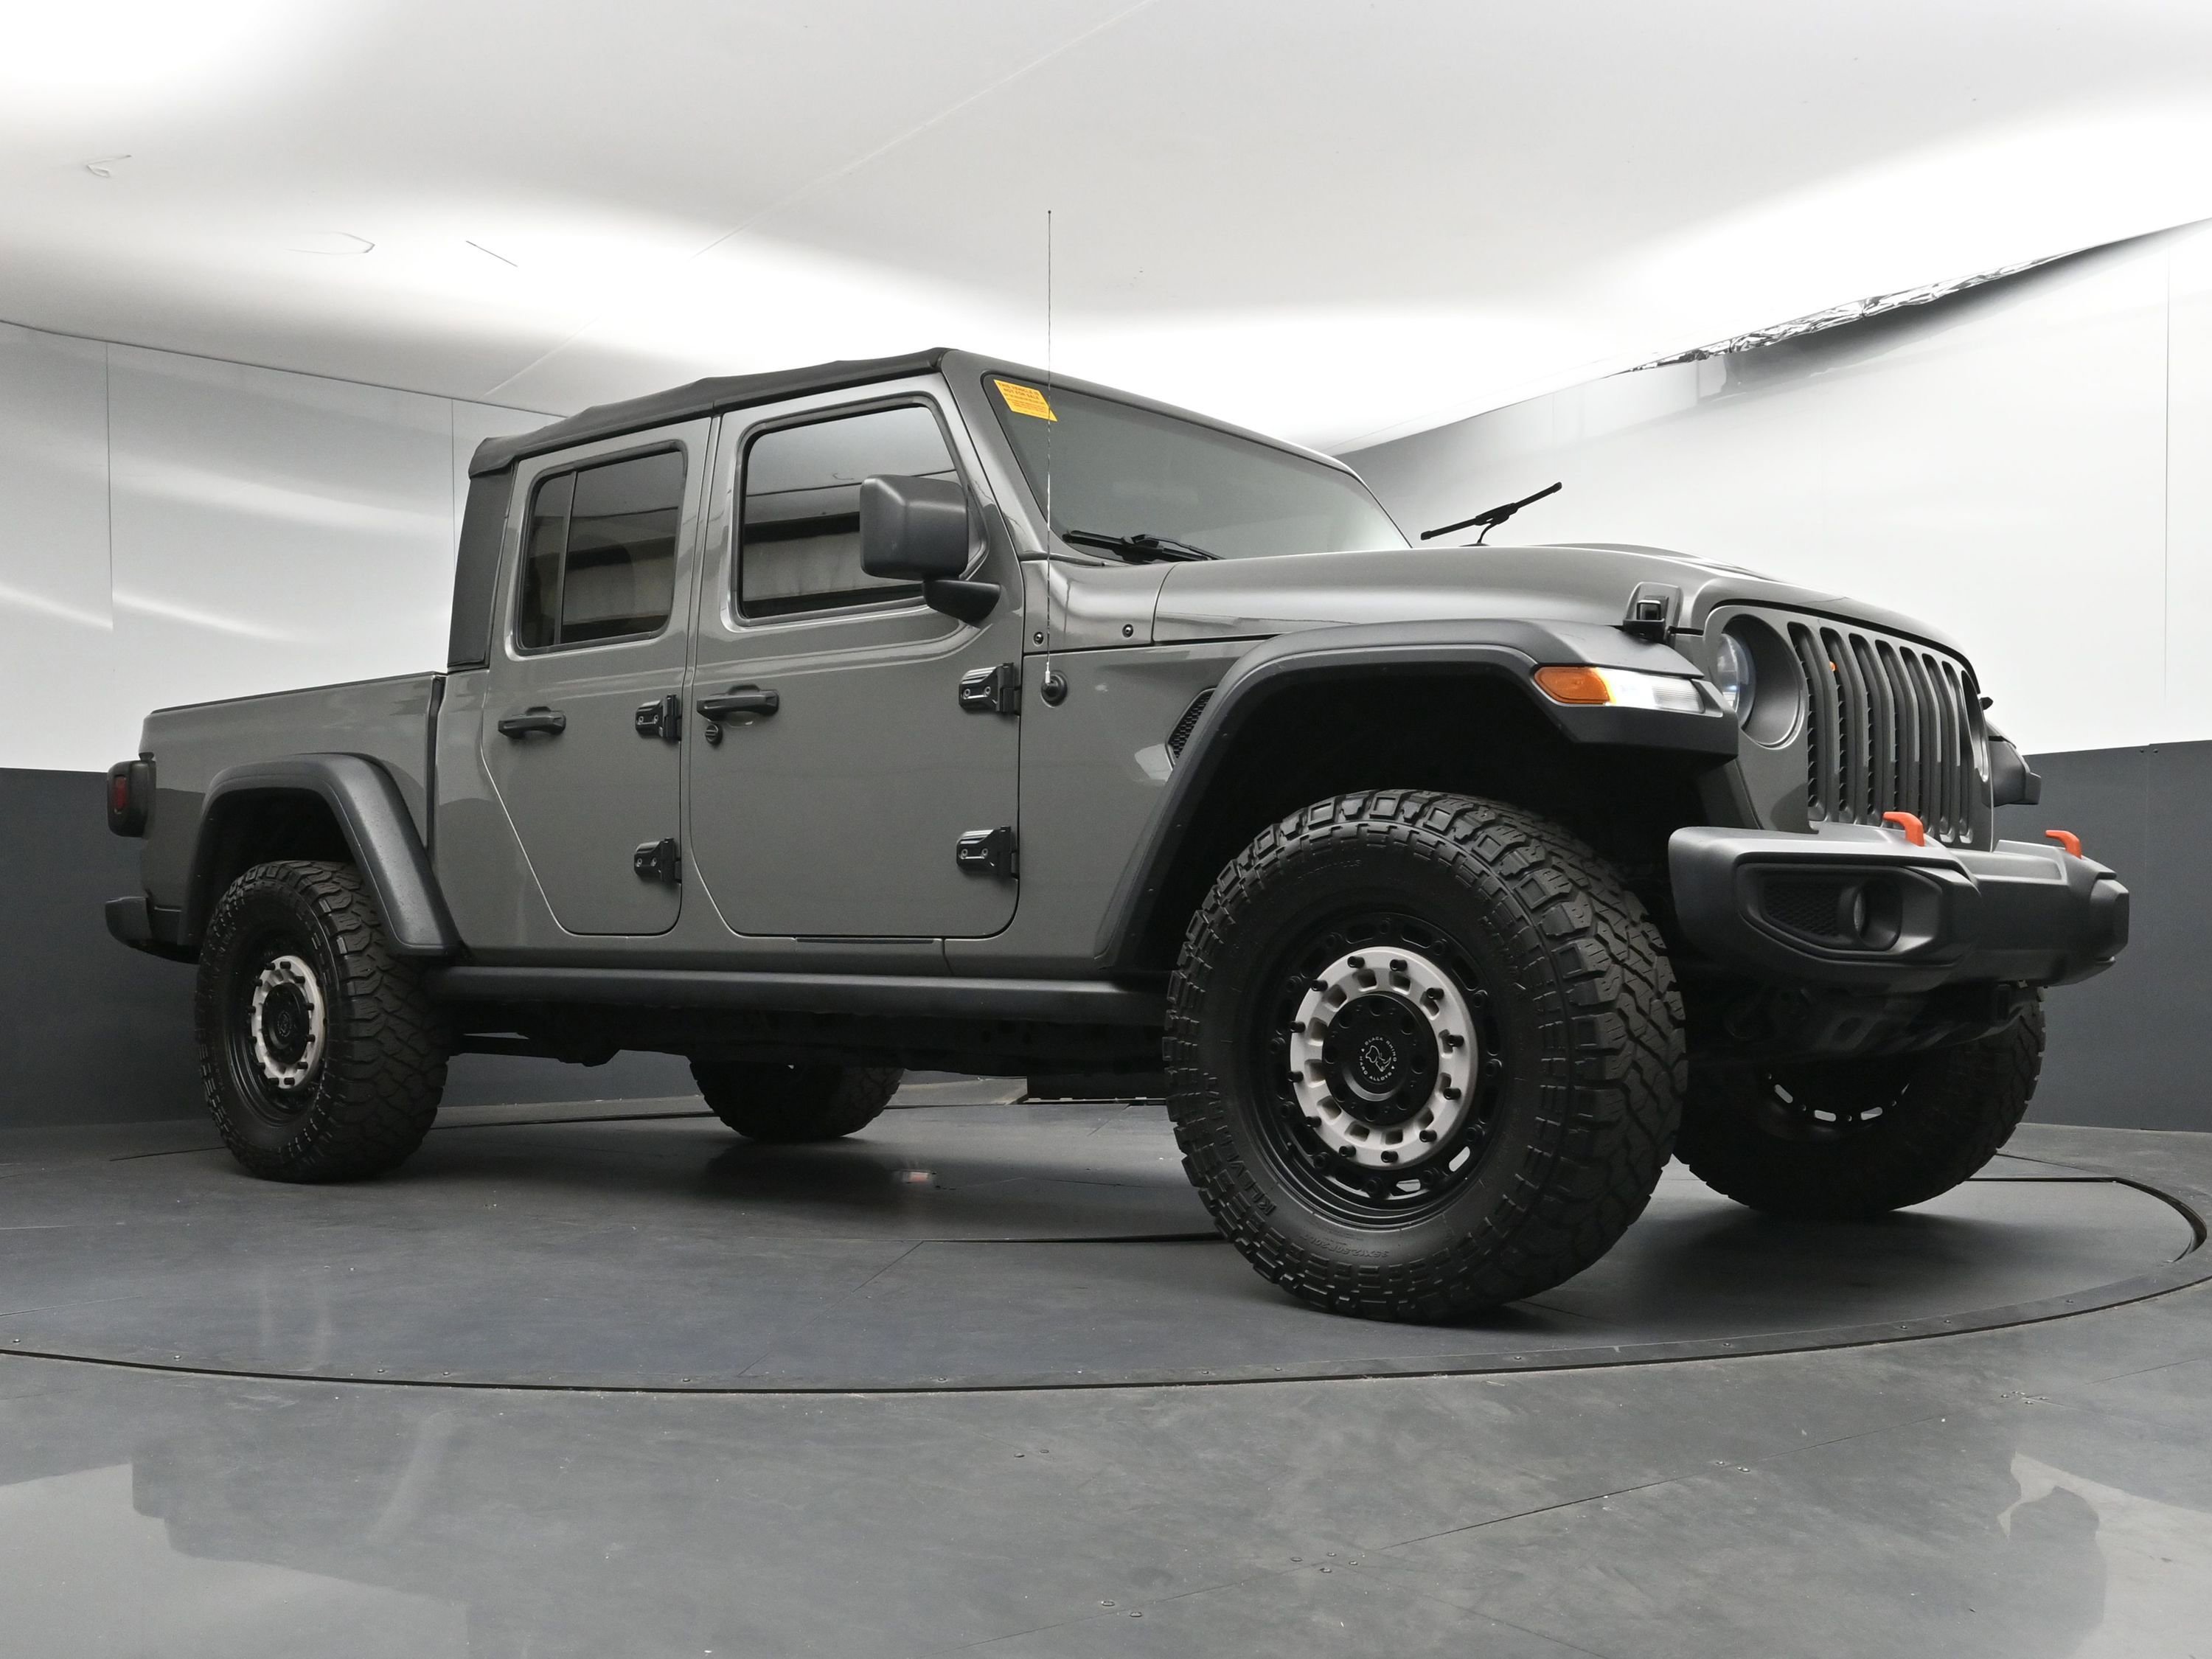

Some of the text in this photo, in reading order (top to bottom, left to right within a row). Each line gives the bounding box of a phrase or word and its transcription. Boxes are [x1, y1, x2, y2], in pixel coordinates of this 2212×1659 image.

[1364, 1036, 1397, 1062] BLACK RHINO
[1359, 1056, 1392, 1082] HARD ALLOYS
